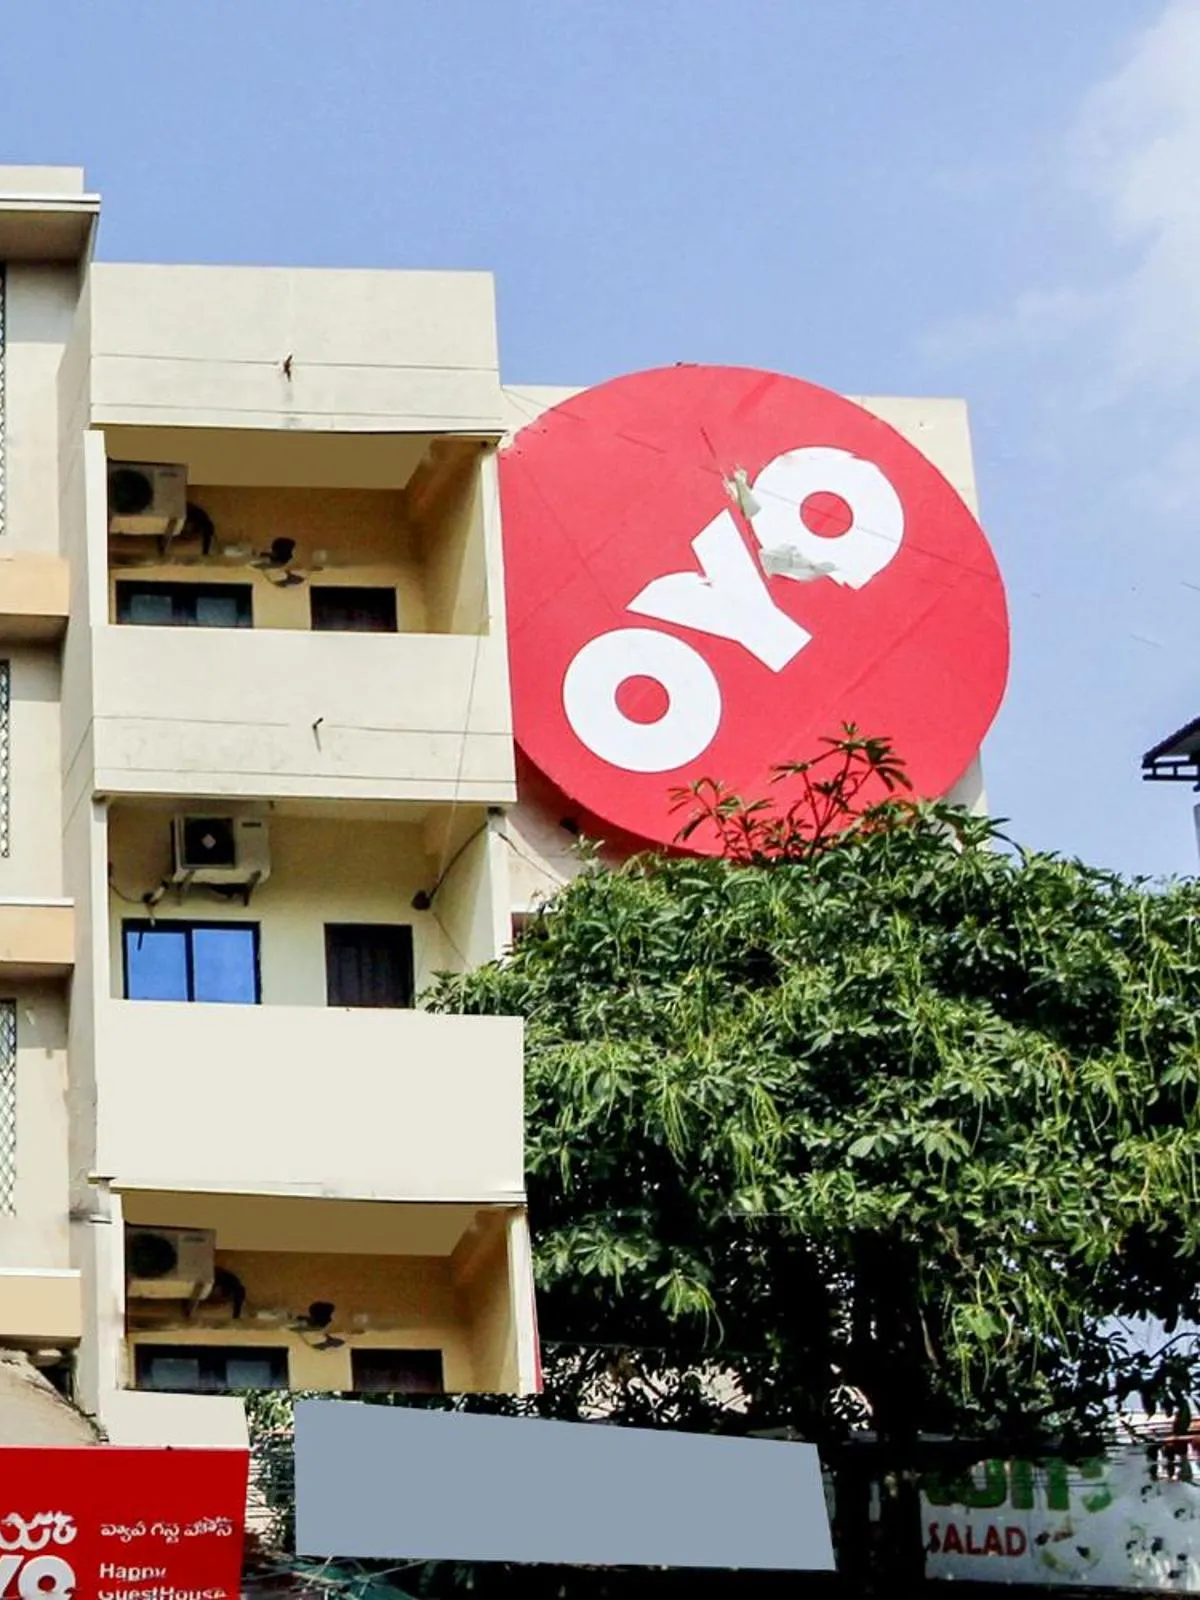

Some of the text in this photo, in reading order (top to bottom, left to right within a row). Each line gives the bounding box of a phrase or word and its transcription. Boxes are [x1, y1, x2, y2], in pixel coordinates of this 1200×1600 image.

[562, 446, 905, 773] OYO
[928, 1521, 1027, 1557] SALAD
[99, 1562, 167, 1582] Happy
